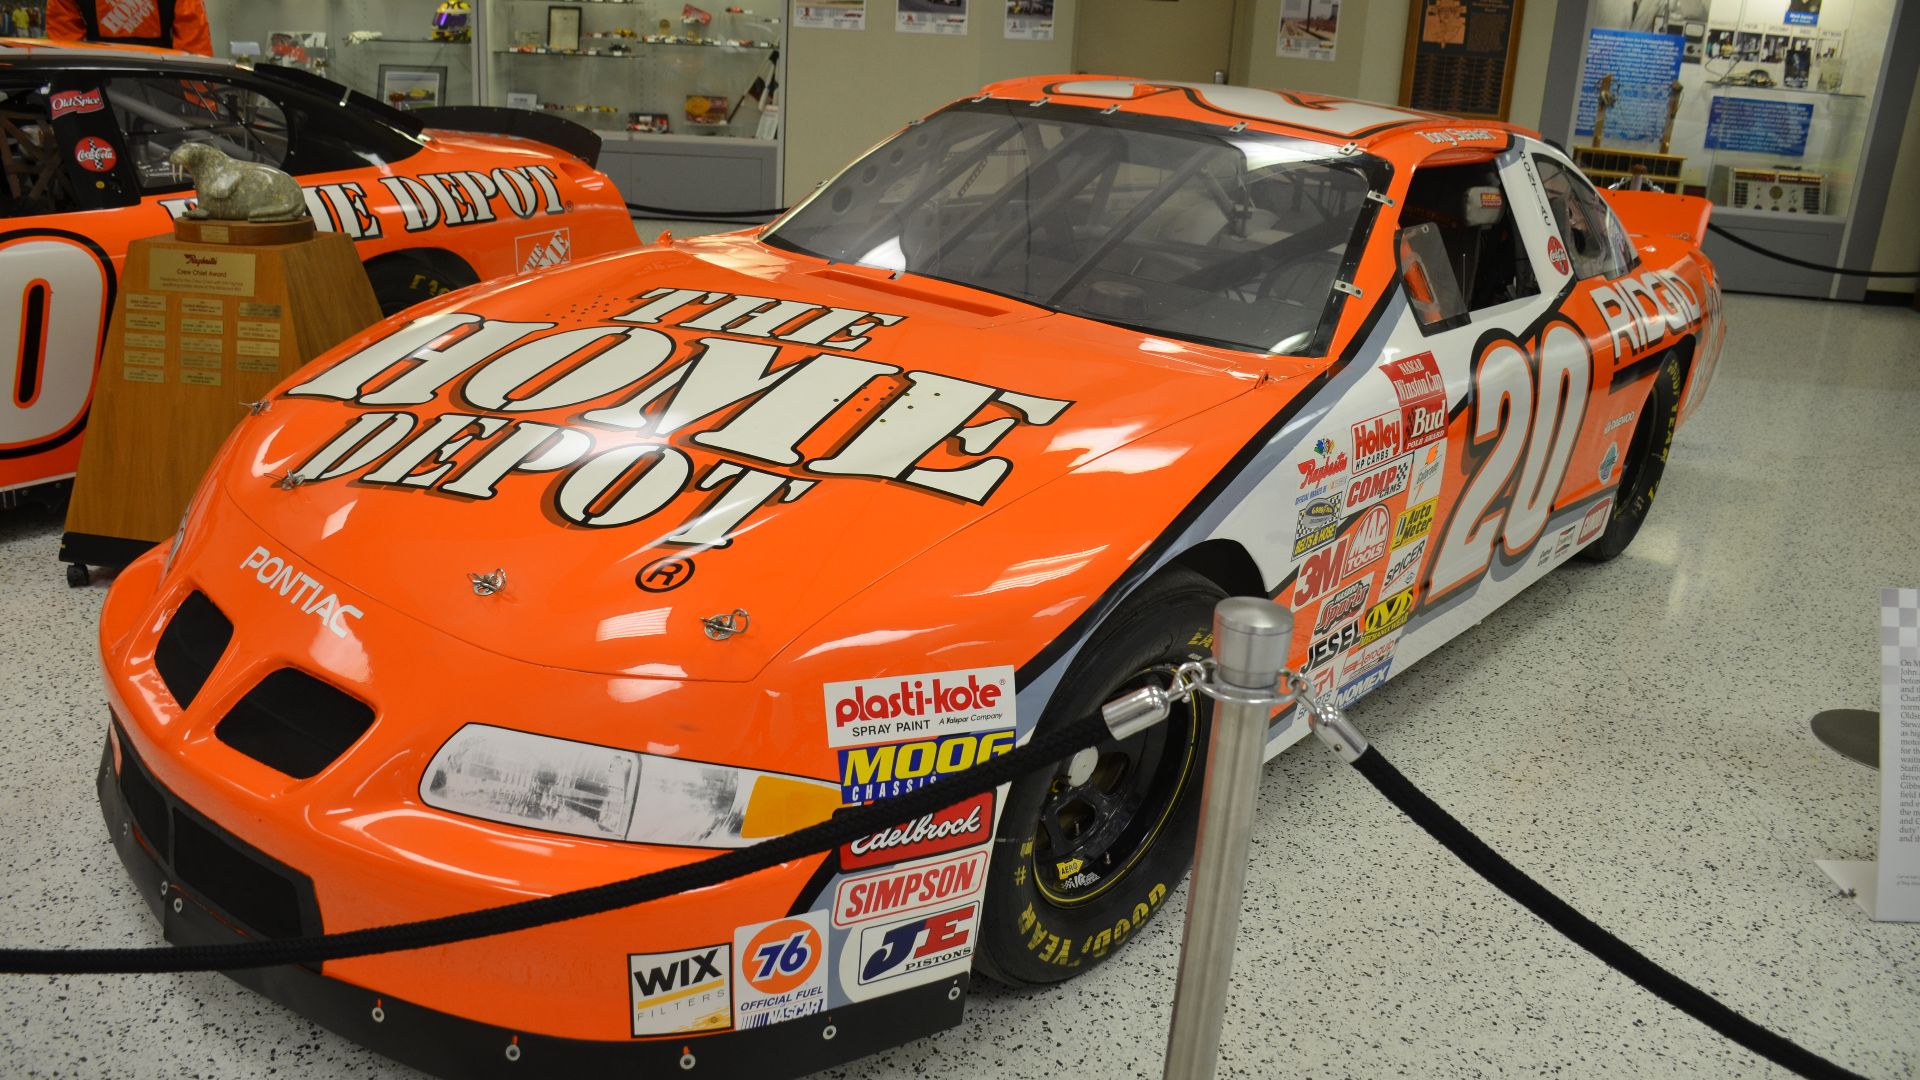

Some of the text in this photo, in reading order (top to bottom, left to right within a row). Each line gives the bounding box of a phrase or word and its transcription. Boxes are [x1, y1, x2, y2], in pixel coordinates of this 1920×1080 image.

[52, 95, 100, 110] Old Spice
[1414, 128, 1458, 146] Tony
[378, 165, 565, 233] DEPOT
[608, 286, 909, 354] THE
[1589, 269, 1700, 360] RIDGID
[1393, 371, 1443, 401] Winston Cup
[1397, 358, 1424, 375] NASCAR
[282, 313, 1076, 506] HOME
[1411, 400, 1446, 438] Bud
[1353, 417, 1401, 460] Holley
[1366, 450, 1389, 466] CARBS
[299, 412, 822, 549] DEPOT
[1297, 451, 1348, 490] Raybestos
[1426, 323, 1592, 603] 20
[1346, 465, 1398, 508] COMP
[1379, 481, 1402, 499] CAMS
[1402, 518, 1433, 542] Meter
[1406, 504, 1432, 526] Auto
[1294, 538, 1348, 607] 3M
[1384, 540, 1426, 586] SPICER
[239, 545, 365, 639] PONTIAC
[1299, 620, 1361, 674] JESEL
[835, 674, 1003, 728] plasti-kote
[1335, 664, 1390, 707] NOMEX
[852, 724, 892, 737] SPRAY
[896, 719, 931, 732] PAINT
[970, 712, 1003, 722] Company
[843, 730, 1015, 787] MOOG
[845, 858, 978, 918] SIMPSON
[1061, 862, 1079, 875] AERO
[757, 933, 808, 978] 76
[863, 904, 976, 981] JE
[904, 947, 973, 971] PISTONS
[633, 948, 723, 997] WIX
[636, 989, 726, 1021] FILTERS
[740, 986, 824, 1011] OFFICIAL FUEL
